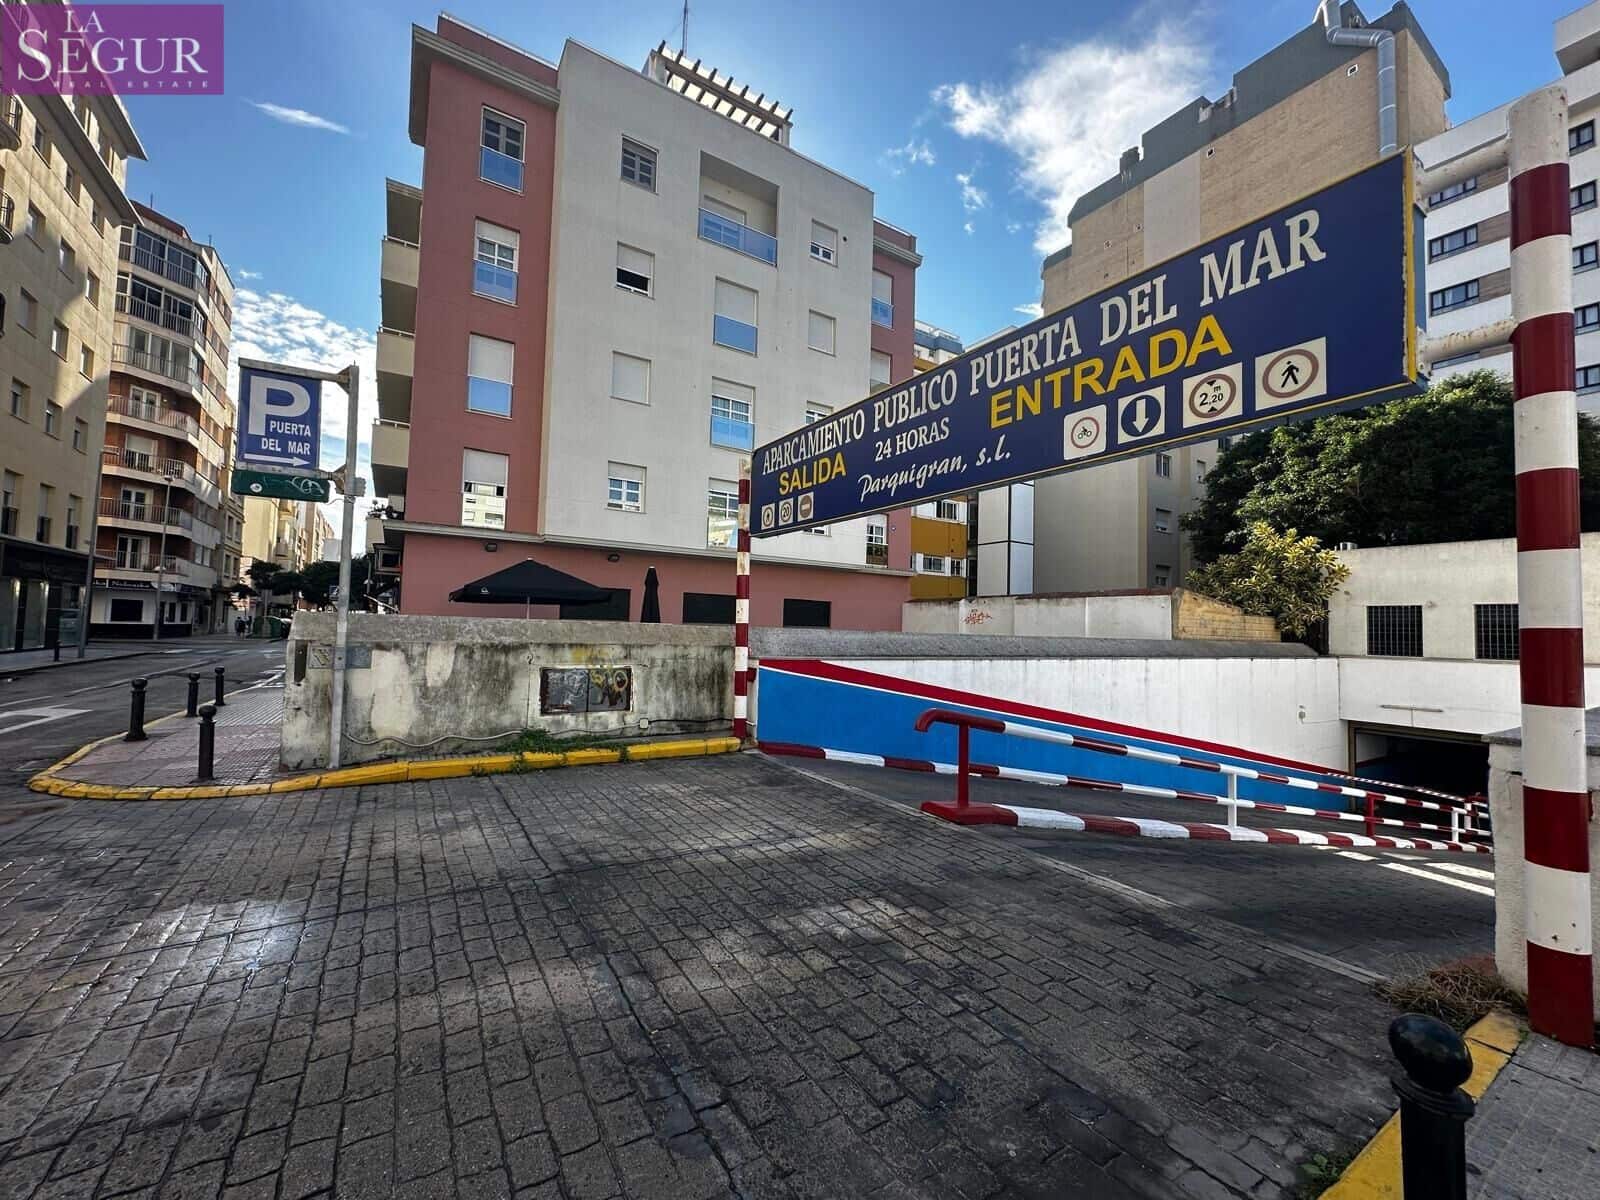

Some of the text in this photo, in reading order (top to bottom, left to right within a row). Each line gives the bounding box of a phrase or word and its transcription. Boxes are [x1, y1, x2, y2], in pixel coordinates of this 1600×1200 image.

[762, 209, 1326, 475] APARCAMIENTO PUBLICO PUERTA DEL MAR
[990, 314, 1232, 429] ENTRADA
[248, 375, 311, 436] P
[269, 420, 311, 437] PUERTA
[261, 438, 311, 455] DEL MAR
[875, 418, 950, 461] 24 HORAS
[778, 452, 847, 495] SALIDA
[858, 434, 1011, 503] Parquigran, s.l.
